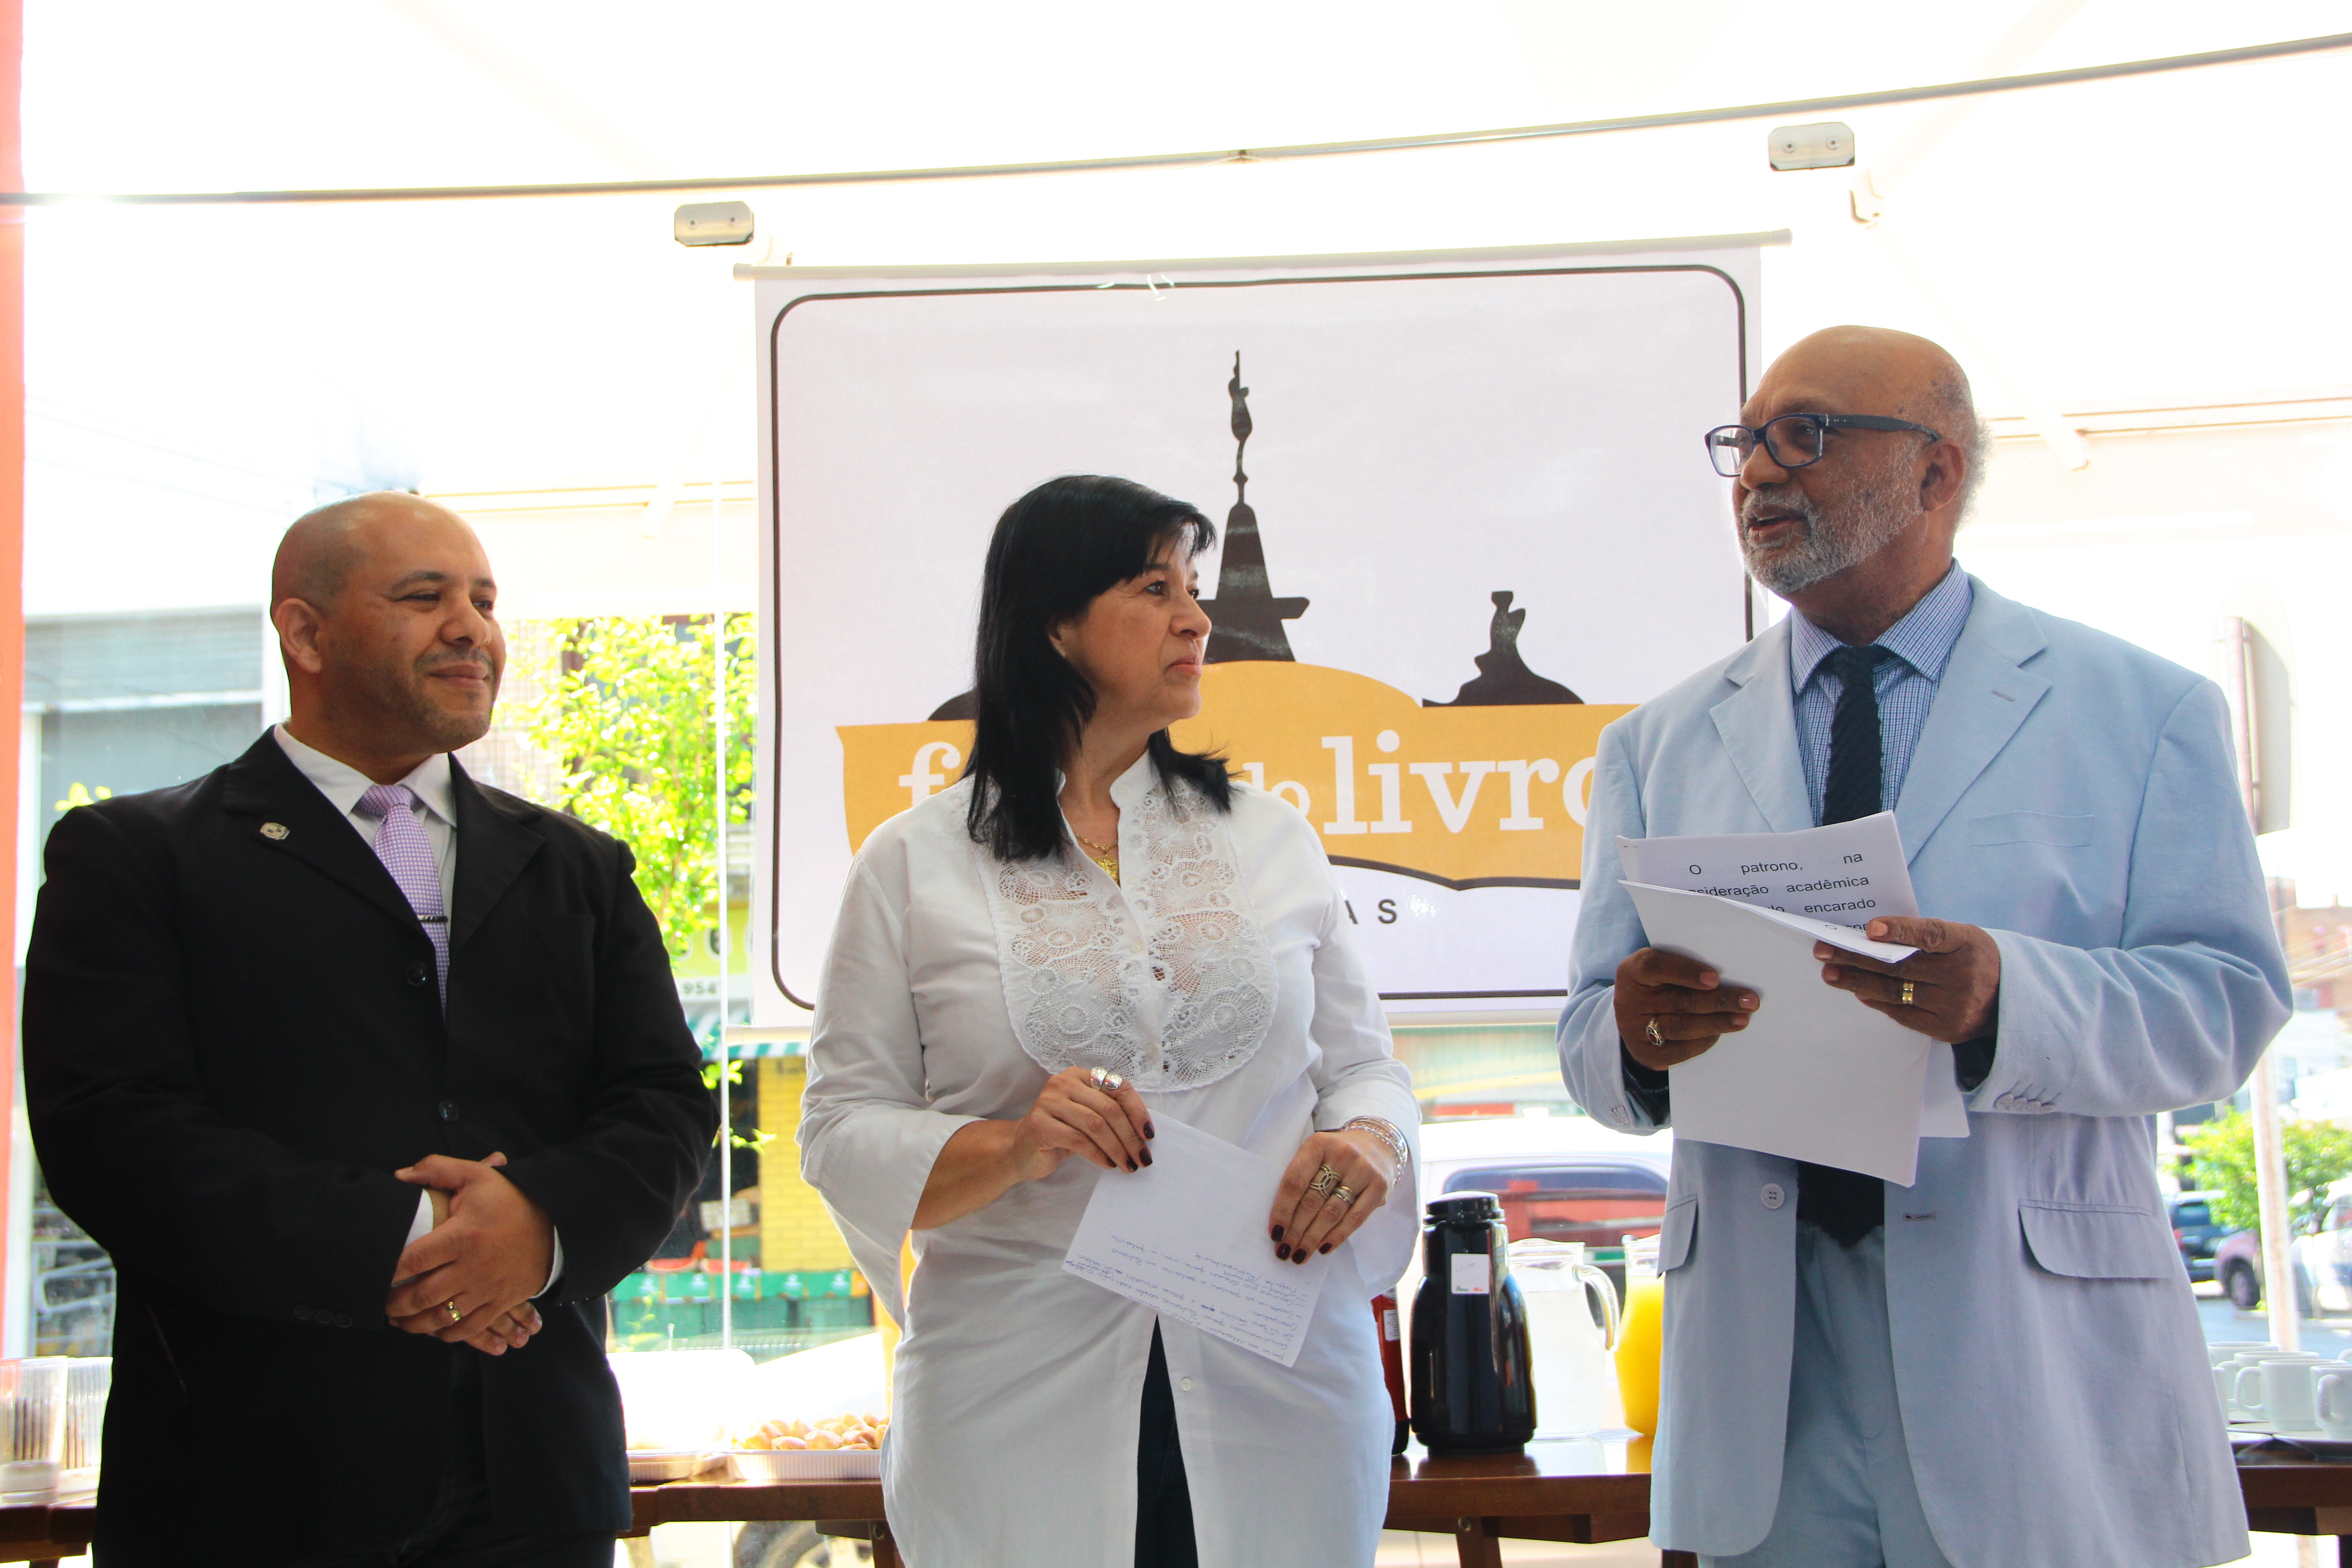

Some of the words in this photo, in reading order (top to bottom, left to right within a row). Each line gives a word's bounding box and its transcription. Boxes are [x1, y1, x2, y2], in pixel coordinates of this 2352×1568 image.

[1689, 864, 1701, 875] O
[1740, 862, 1803, 876] patrono,
[1843, 853, 1863, 864] na
[1688, 884, 1769, 897] sideração
[1786, 877, 1870, 892] acadêmica
[1804, 898, 1876, 913] encarado
[682, 982, 721, 995] 954
